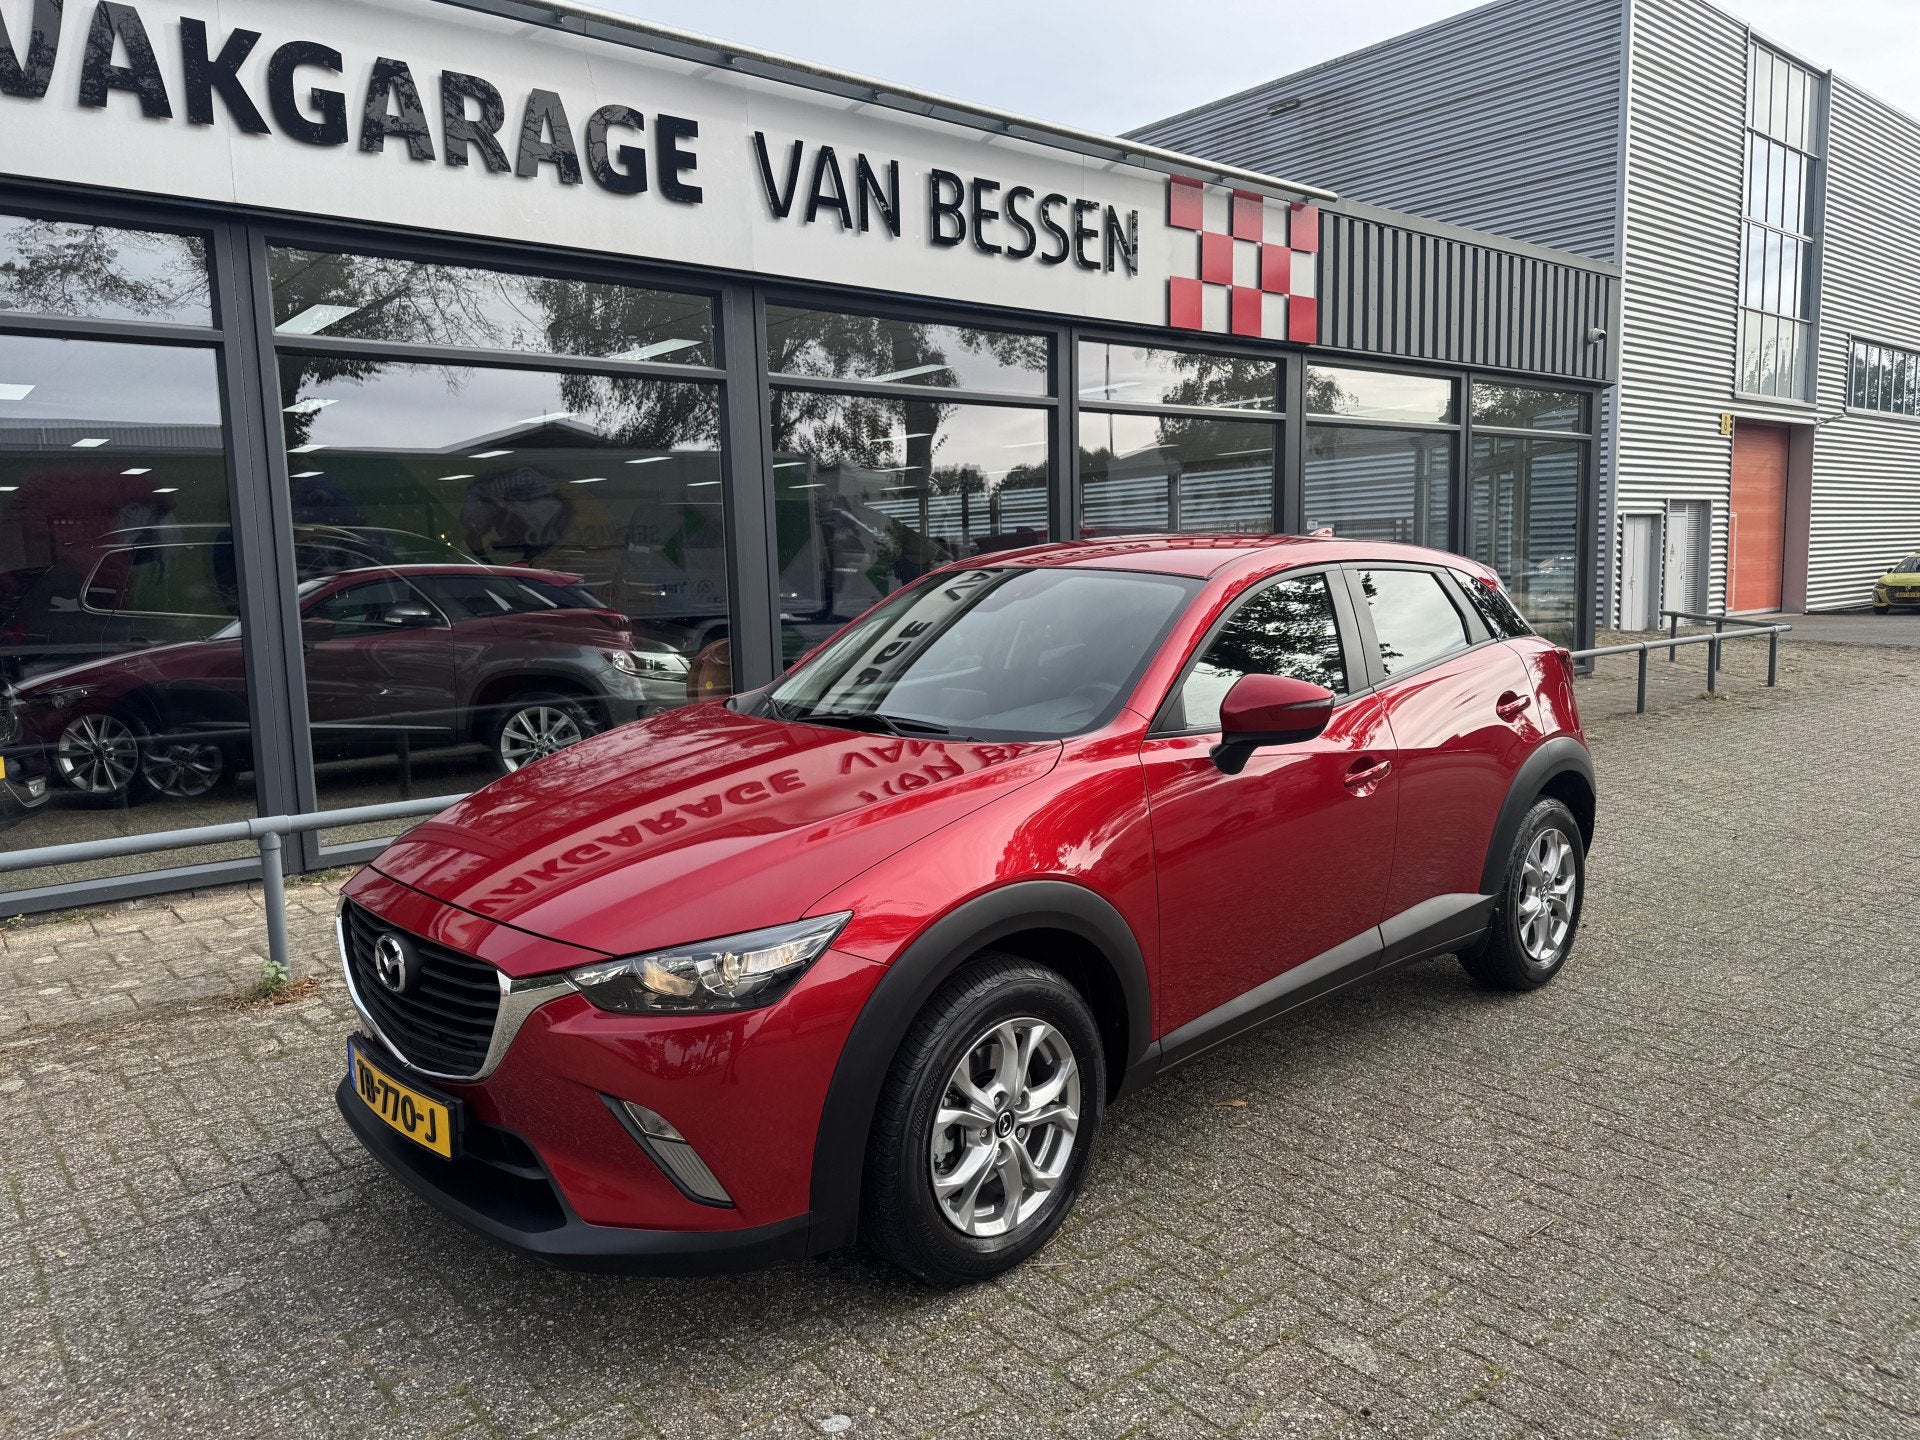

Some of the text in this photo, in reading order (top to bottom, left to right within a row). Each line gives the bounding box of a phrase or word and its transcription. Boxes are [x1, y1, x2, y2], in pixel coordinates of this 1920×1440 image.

[0, 0, 1140, 277] VAKGARAGE VAN BESSEN
[356, 1057, 437, 1143] TB-770-J
